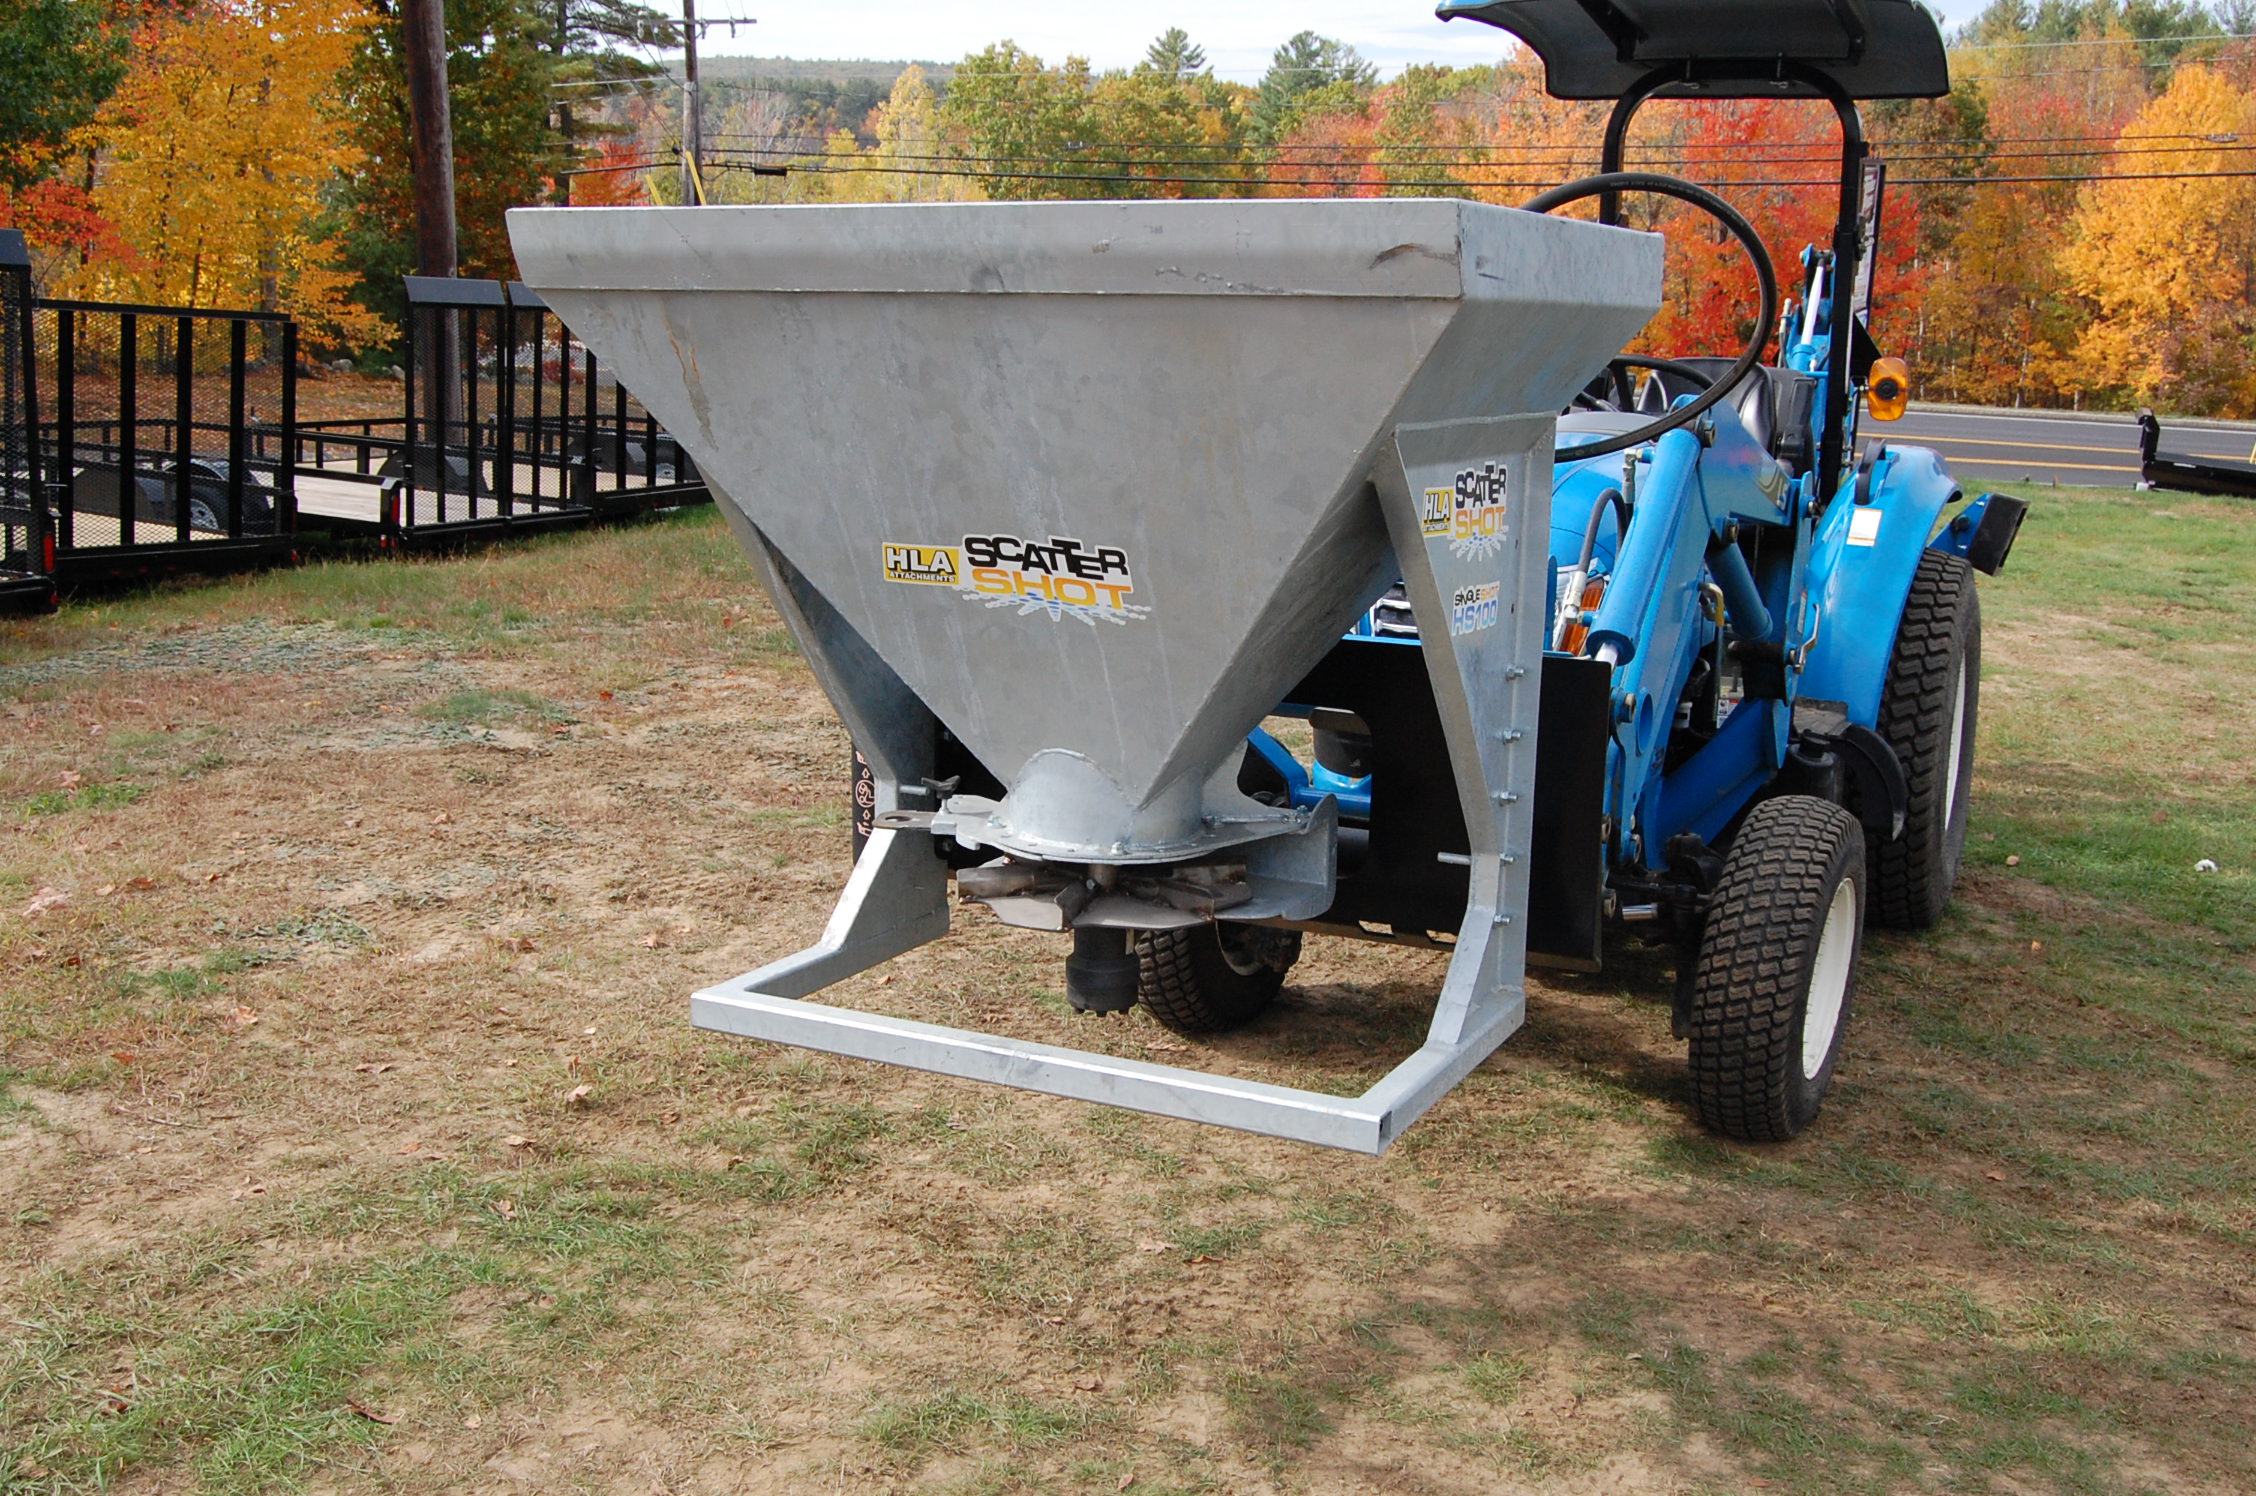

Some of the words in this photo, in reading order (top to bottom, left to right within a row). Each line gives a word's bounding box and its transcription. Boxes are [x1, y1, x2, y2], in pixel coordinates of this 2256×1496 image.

[1456, 464, 1507, 508] SCATTER
[1423, 492, 1451, 523] HLA
[1456, 506, 1506, 539] SHOT
[886, 547, 956, 575] HLA
[964, 537, 1129, 581] SCATTER
[889, 571, 955, 583] ATTACHMENTS
[972, 568, 1132, 610] SHOT
[1452, 600, 1497, 634] HS100
